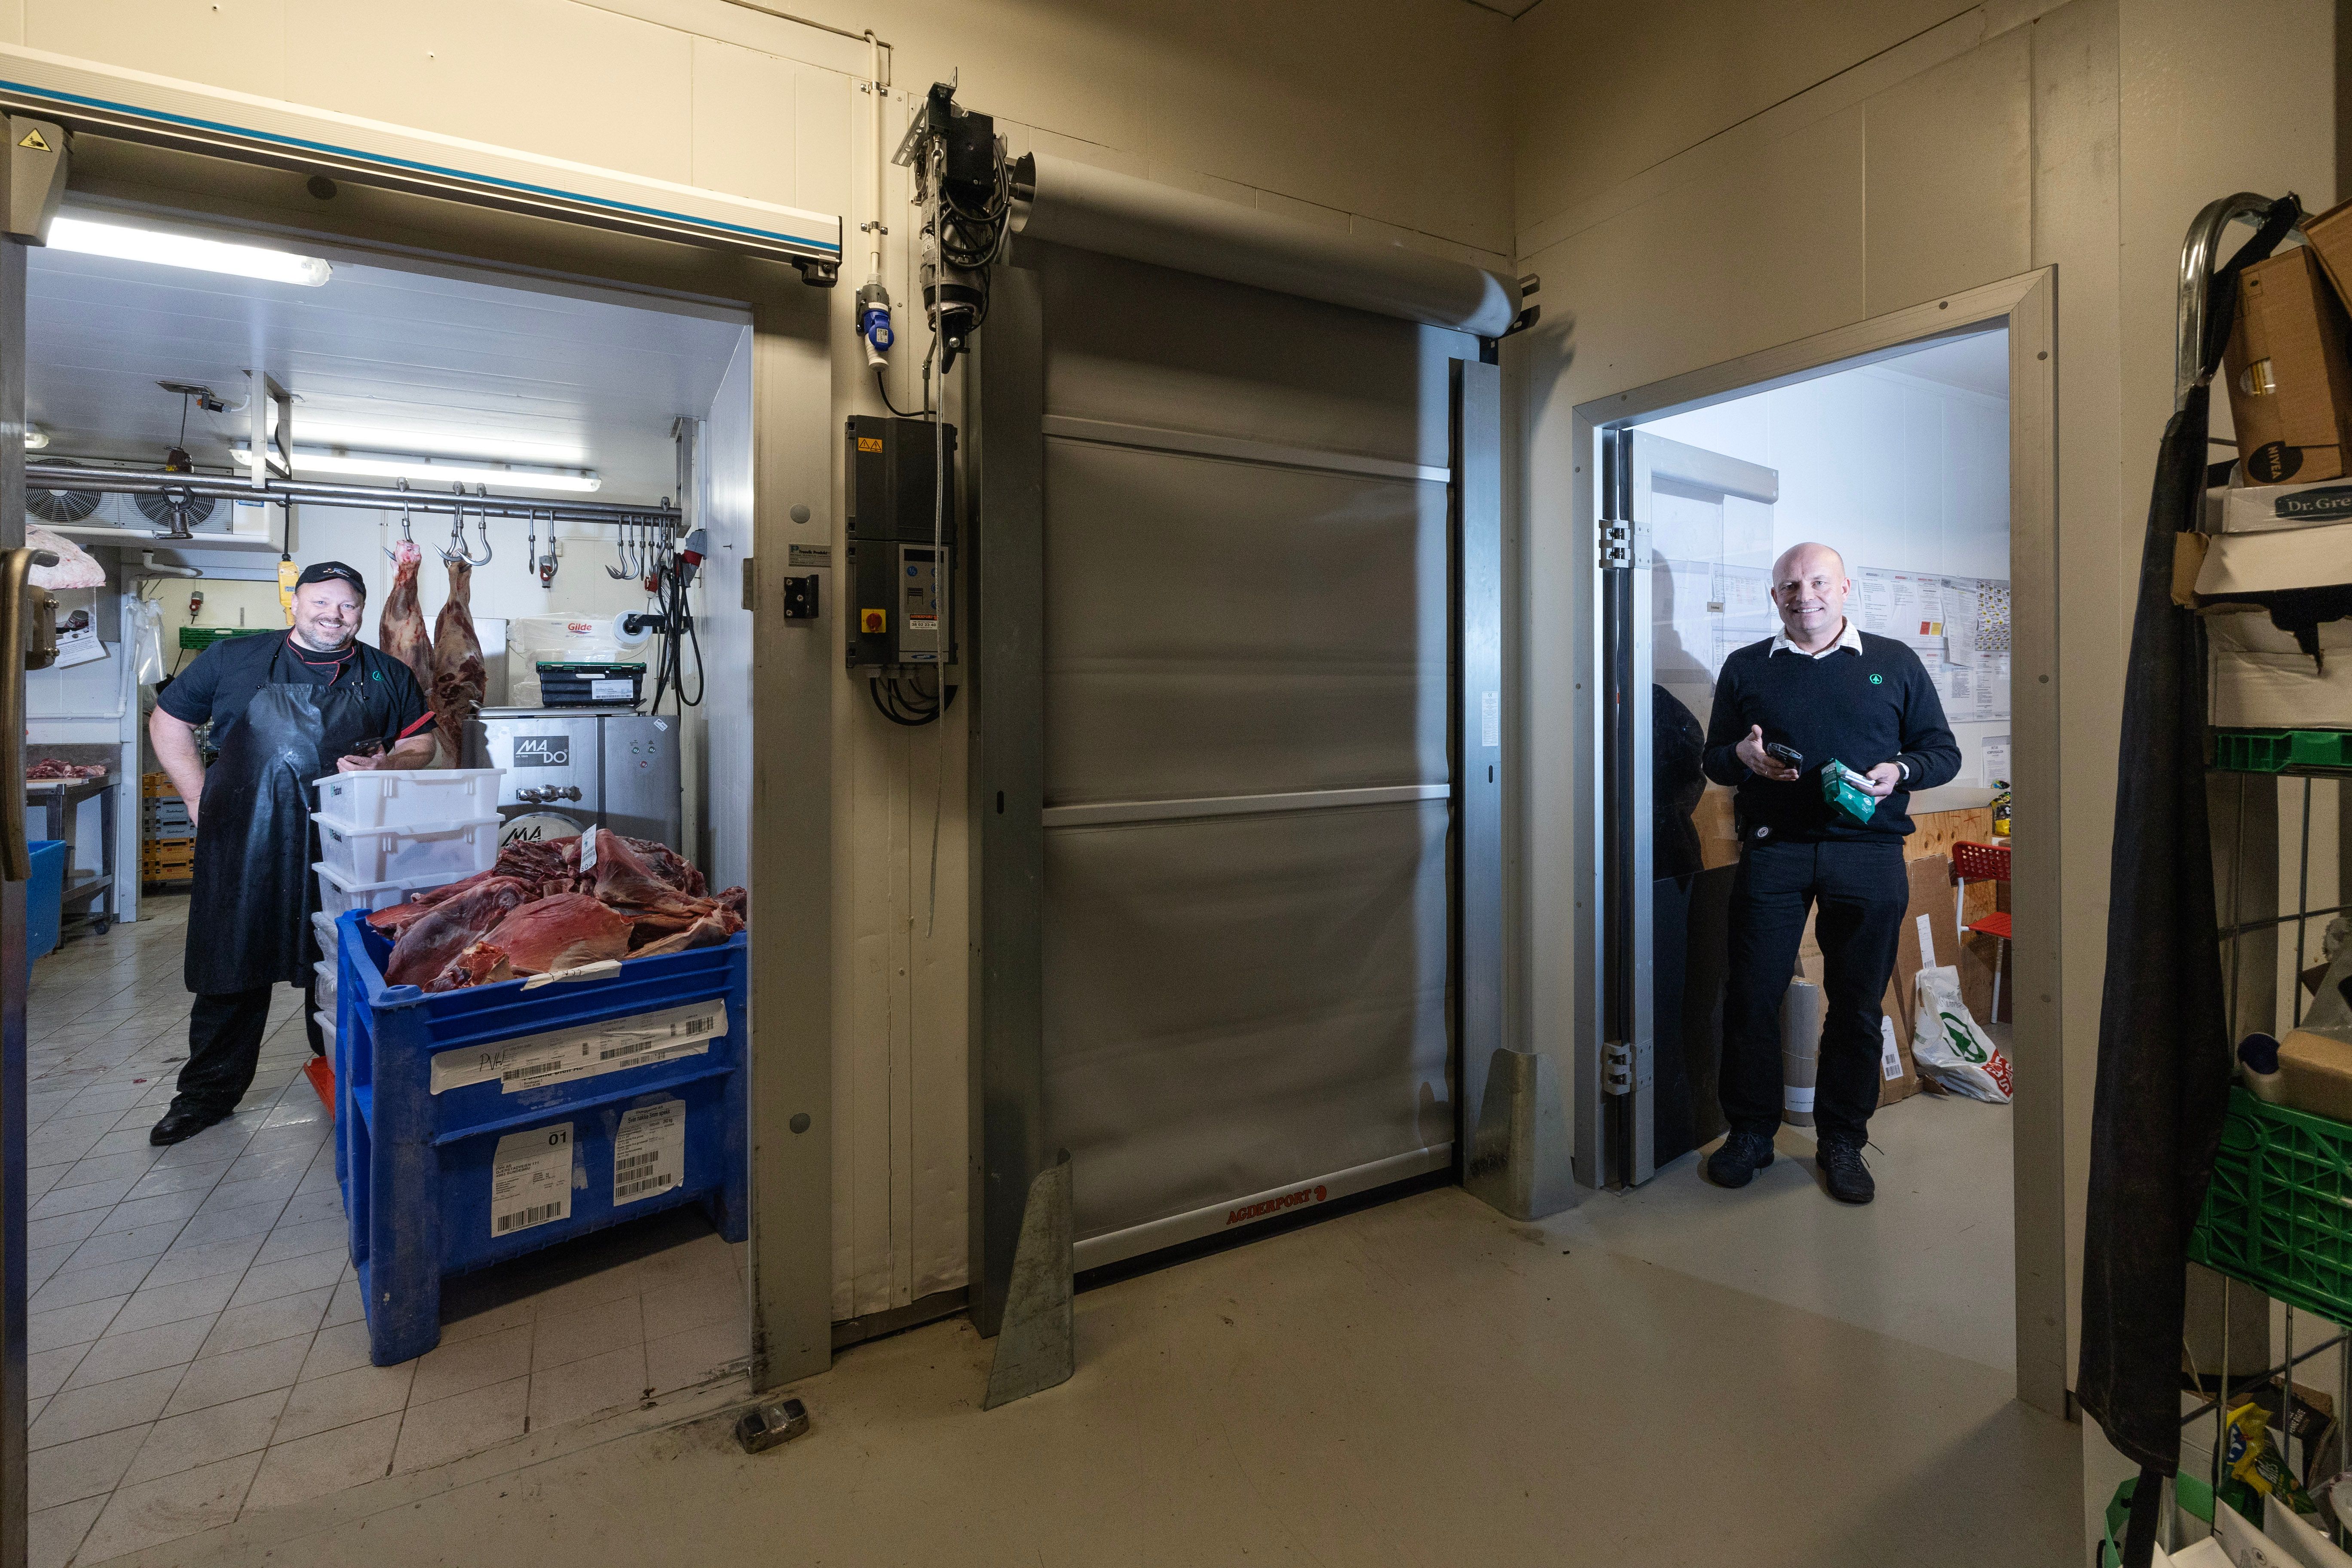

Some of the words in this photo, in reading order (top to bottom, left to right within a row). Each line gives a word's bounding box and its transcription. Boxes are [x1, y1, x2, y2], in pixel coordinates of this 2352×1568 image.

[2268, 446, 2282, 480] NIVEA
[480, 1051, 505, 1072] PVH
[549, 1131, 567, 1145] 01
[1226, 1189, 1312, 1225] AGDERPORT
